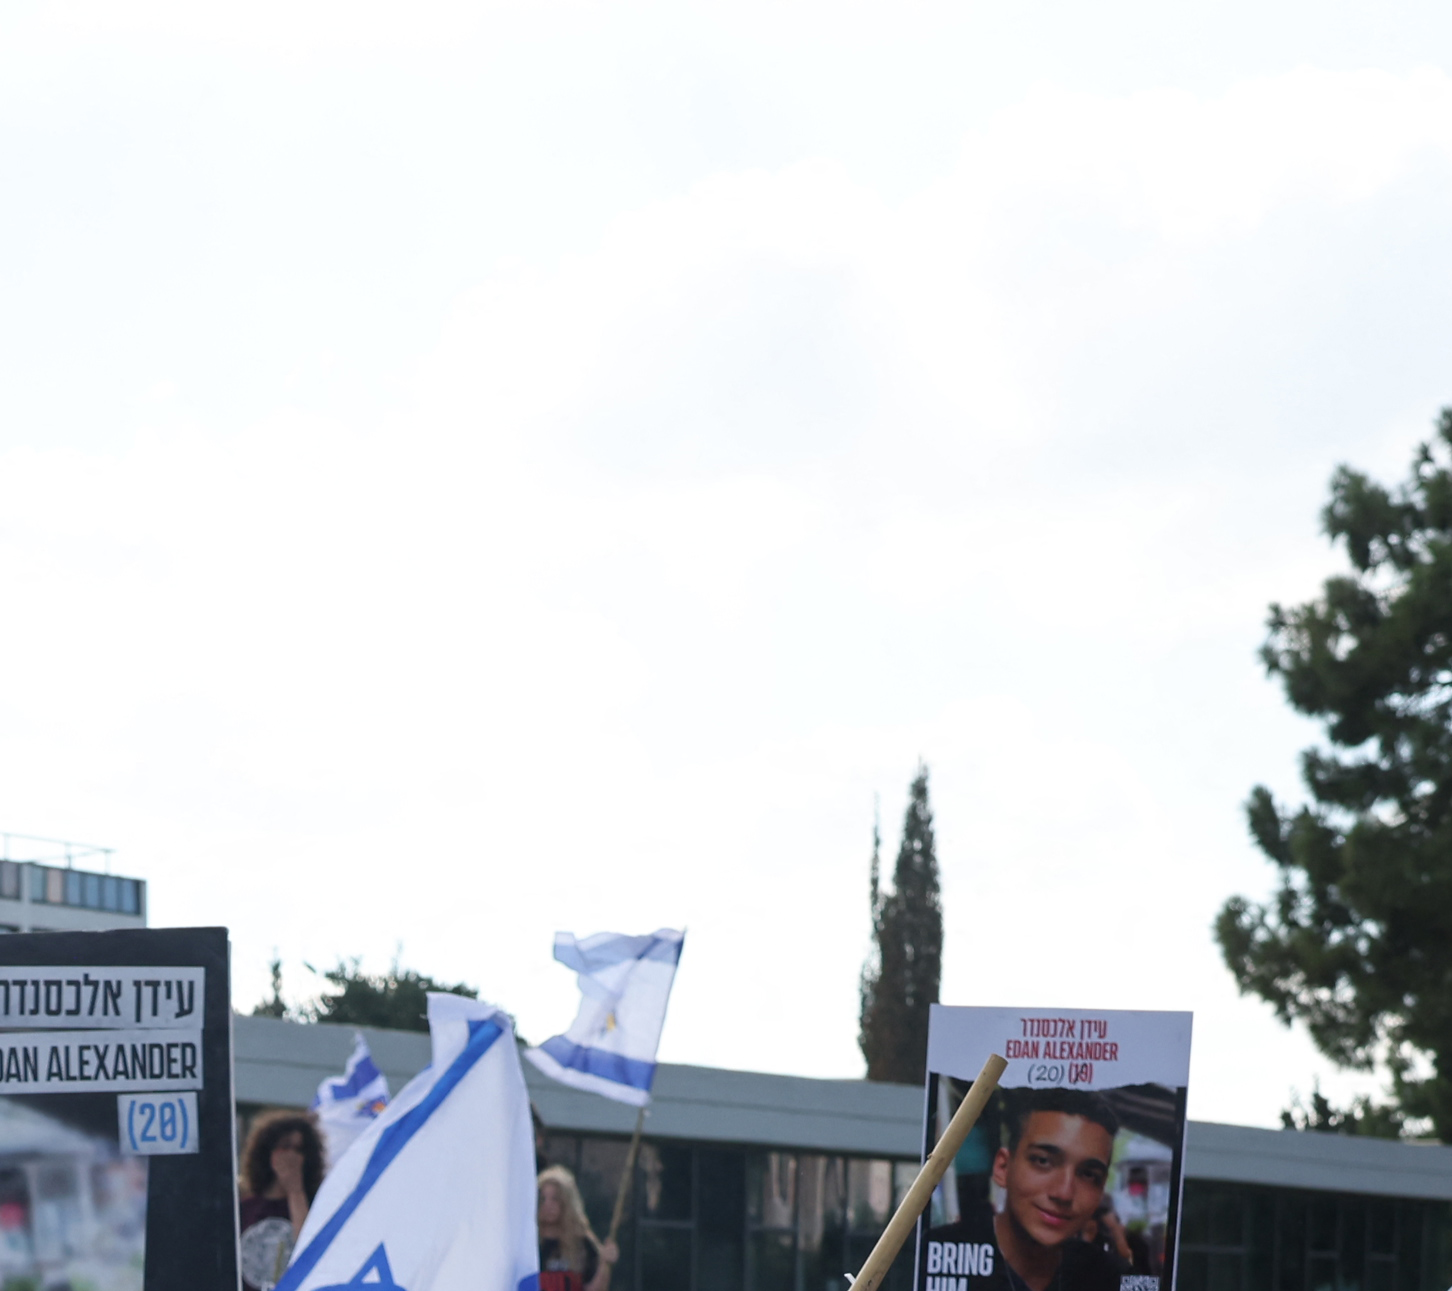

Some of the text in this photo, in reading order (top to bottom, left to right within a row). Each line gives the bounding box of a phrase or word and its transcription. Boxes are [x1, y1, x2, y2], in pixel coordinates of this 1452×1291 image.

[133, 980, 195, 1024] עידן
[1020, 1017, 1108, 1041] עידן אלכסנדר
[46, 1042, 197, 1082] ALEXANDER
[1005, 1039, 1118, 1061] EDAN ALEXANDER
[1027, 1063, 1065, 1084] (20)
[128, 1098, 189, 1151] (20)
[927, 1241, 994, 1277] BRING
